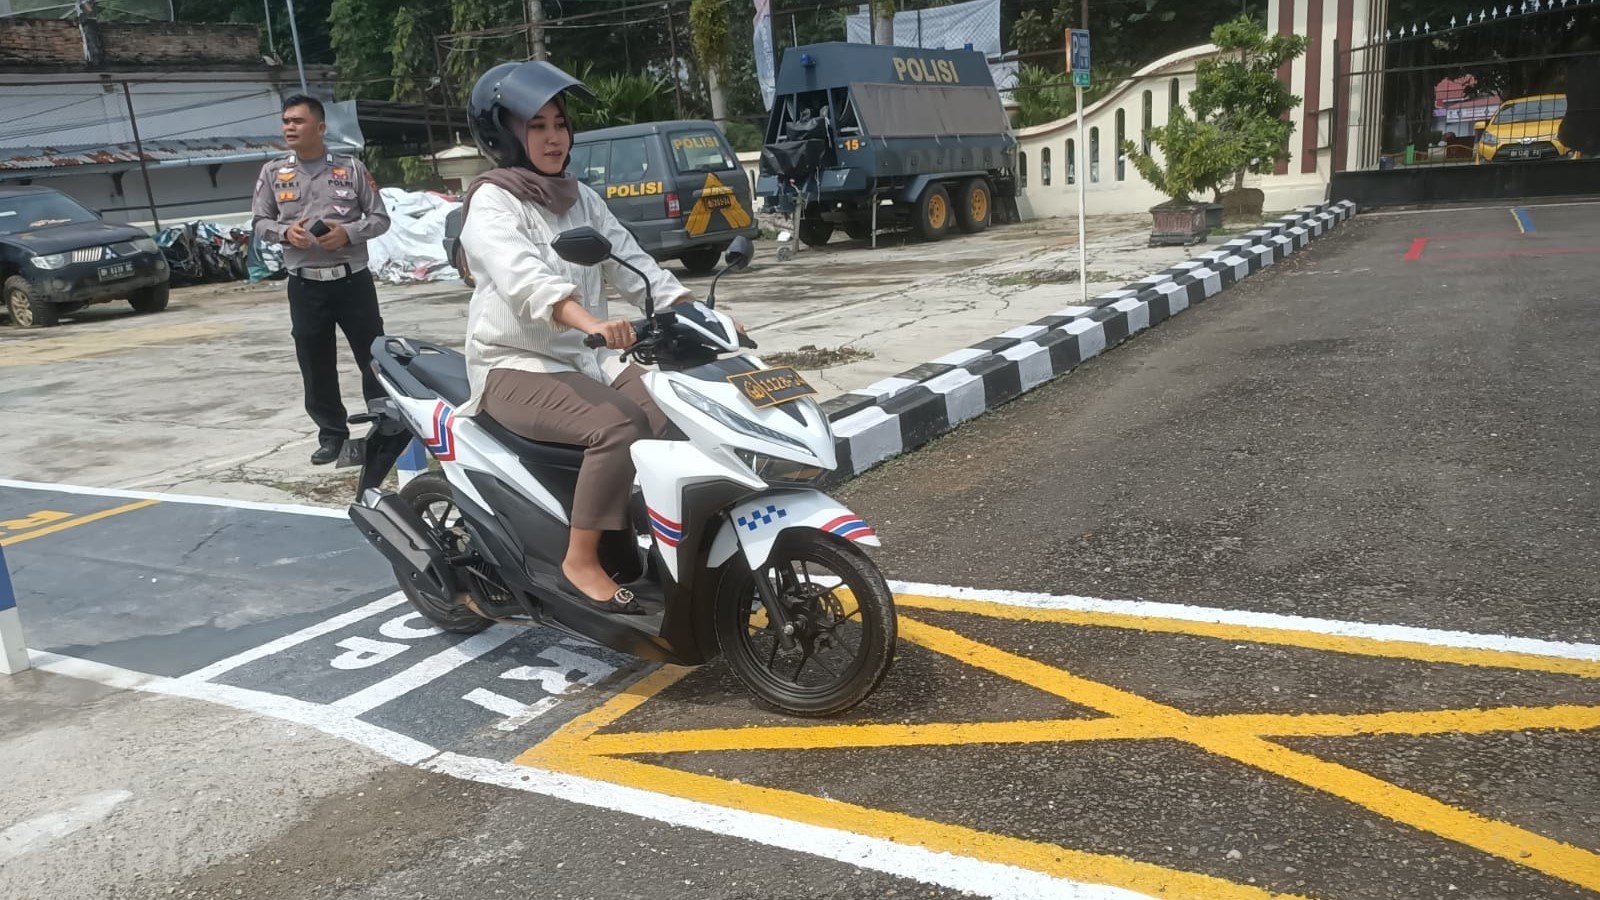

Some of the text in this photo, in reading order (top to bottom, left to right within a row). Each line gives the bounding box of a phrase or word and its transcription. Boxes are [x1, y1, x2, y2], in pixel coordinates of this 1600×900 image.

[892, 56, 960, 83] POLISI
[671, 136, 720, 150] POLISI
[844, 139, 860, 152] 15
[327, 179, 353, 187] POLRI
[606, 181, 664, 199] POLISI
